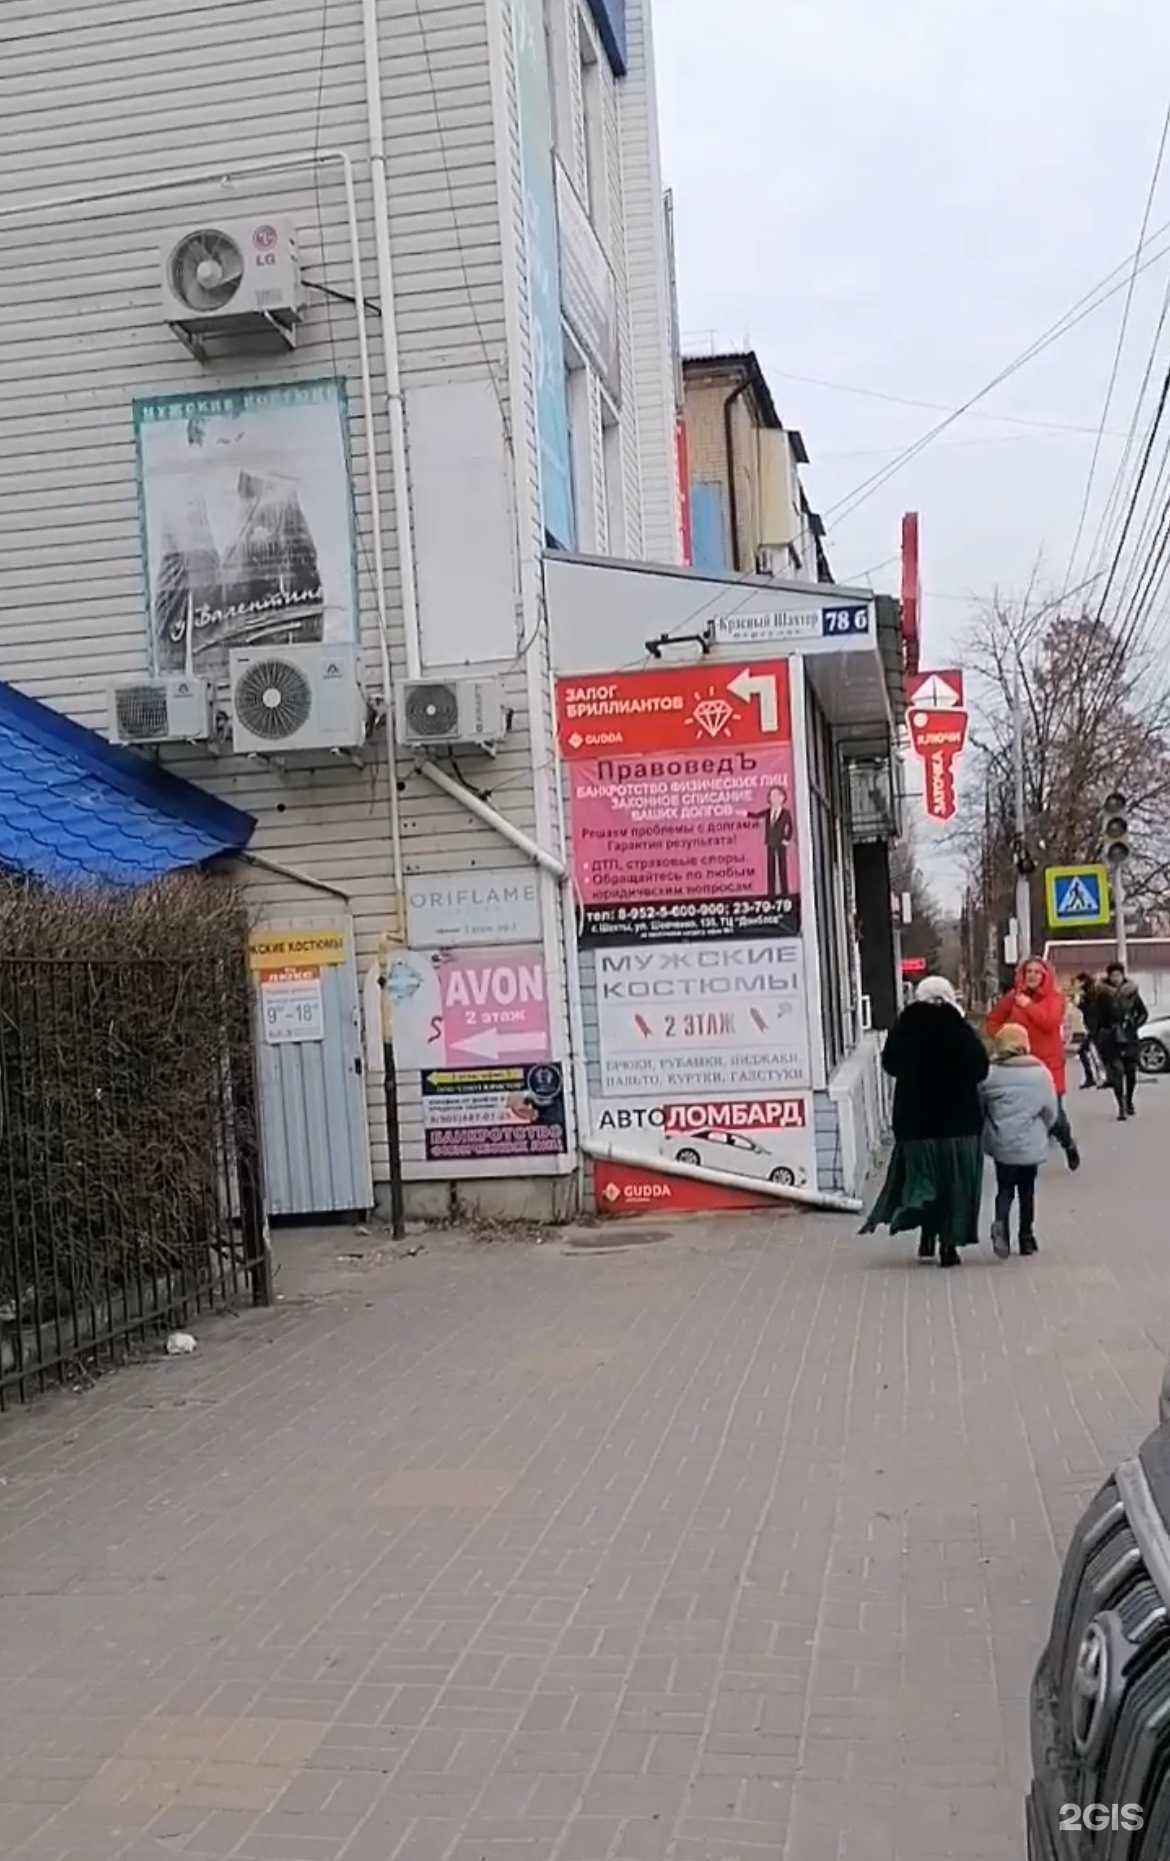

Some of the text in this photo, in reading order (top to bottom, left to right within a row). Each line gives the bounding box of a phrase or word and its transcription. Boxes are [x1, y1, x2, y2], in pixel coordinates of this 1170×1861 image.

[256, 254, 276, 266] LG
[825, 610, 850, 632] 78
[565, 685, 617, 702] ЗАЛОГ
[566, 695, 684, 718] БРИЛЛИАНТОВ
[576, 773, 789, 799] БАНКРОТСТВО ФИЗИЧЕСКИХ ЛИЦ
[611, 789, 752, 811] ЗАКОННОЕ СПИСАНИЕ
[631, 804, 733, 821] ВАШИХ ДОЛГОВ
[581, 827, 627, 839] Решаем
[631, 823, 694, 838] проблемы
[607, 840, 663, 852] Гарантия
[625, 857, 697, 872] страховые
[592, 866, 755, 886] Обращайтесь по любым
[410, 885, 535, 908] ORIFLAME
[592, 887, 682, 900] юридическим
[602, 946, 798, 972] МУЖСКИЕ
[446, 964, 544, 1007] AVON
[603, 972, 798, 999] КОСТЮМЫ
[465, 1009, 527, 1024] 2 этаж
[665, 1013, 736, 1037] 2 ЭТАЖ
[599, 1101, 803, 1130] АВТОЛОМБАРД
[623, 1183, 672, 1197] GUDDA
